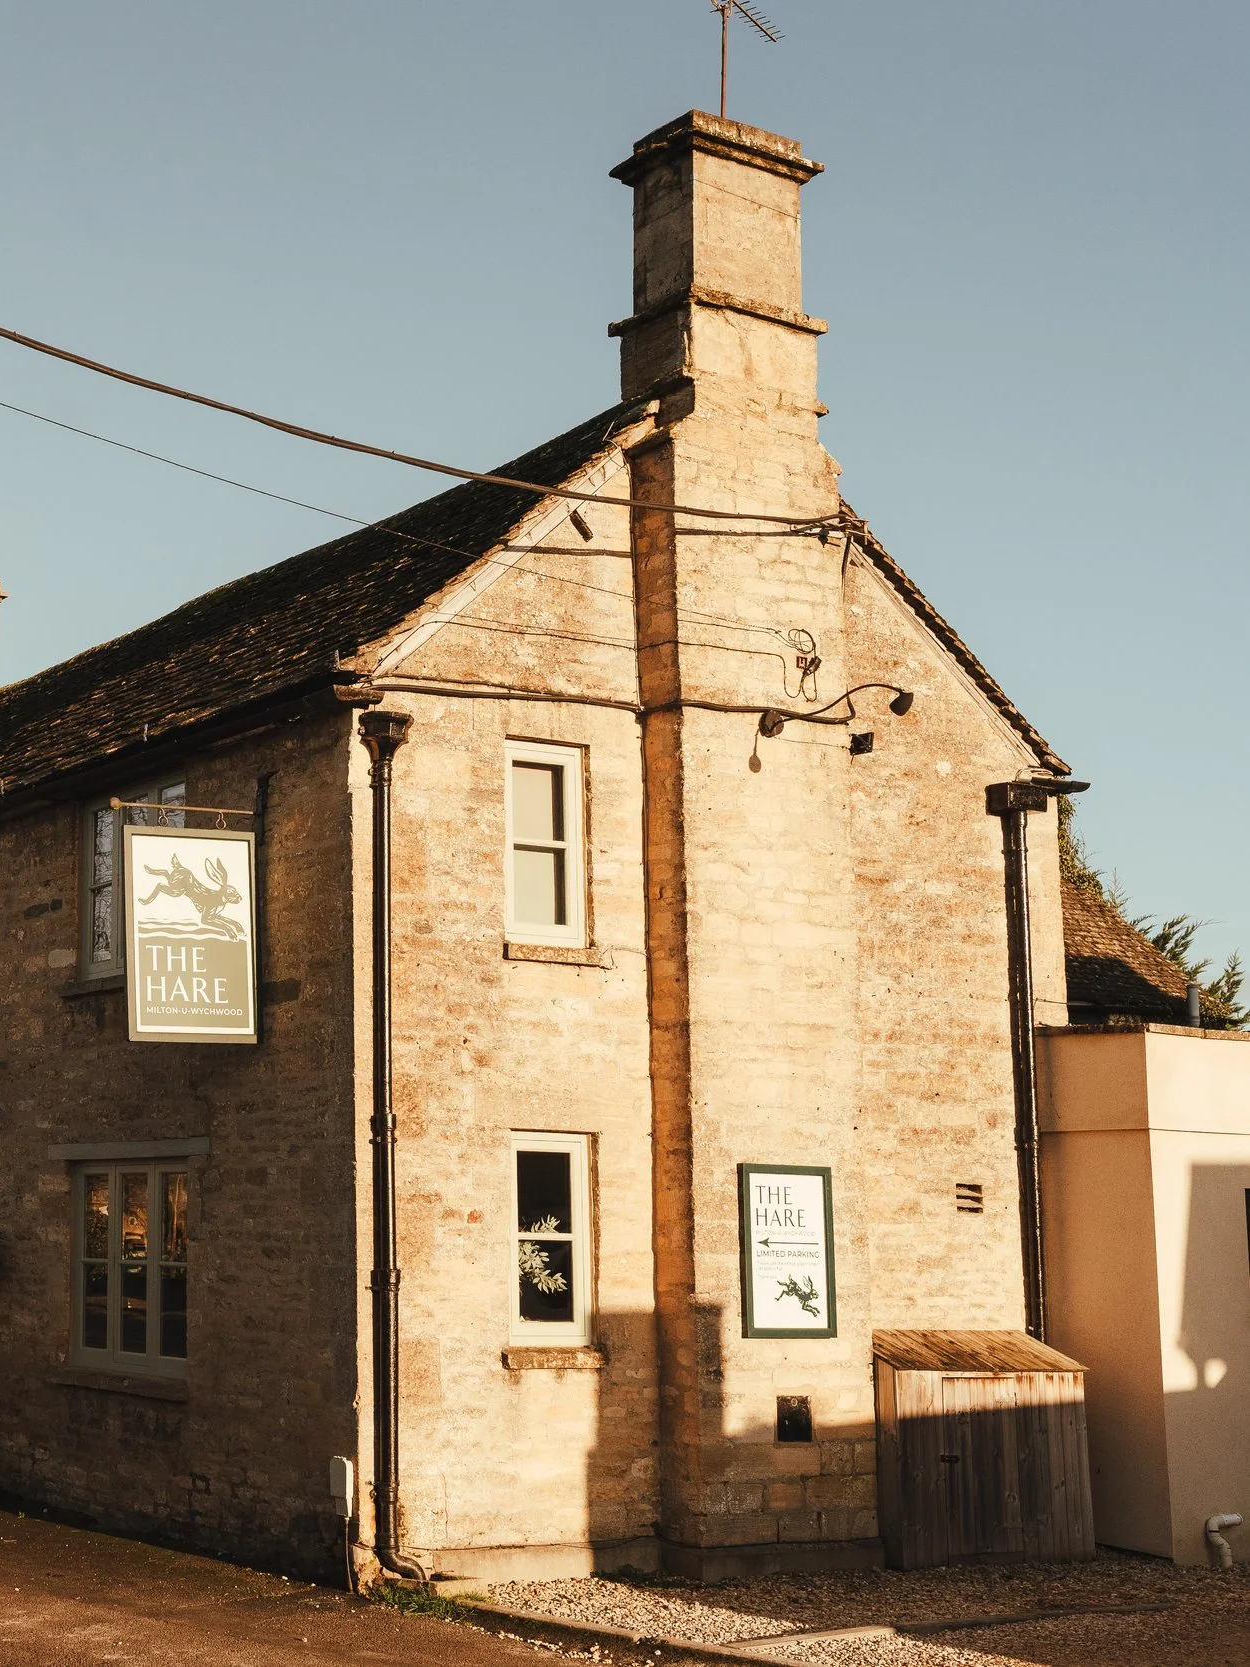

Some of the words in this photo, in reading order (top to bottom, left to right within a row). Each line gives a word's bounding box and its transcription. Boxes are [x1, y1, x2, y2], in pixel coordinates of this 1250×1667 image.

[146, 945, 206, 972] THE
[146, 976, 229, 1004] HARE
[146, 1006, 243, 1016] MILTON-U-WYCHWOOD
[755, 1185, 792, 1205] THE
[755, 1208, 806, 1227] HARE
[756, 1250, 786, 1258] LIMITED
[787, 1250, 820, 1258] PARKING
